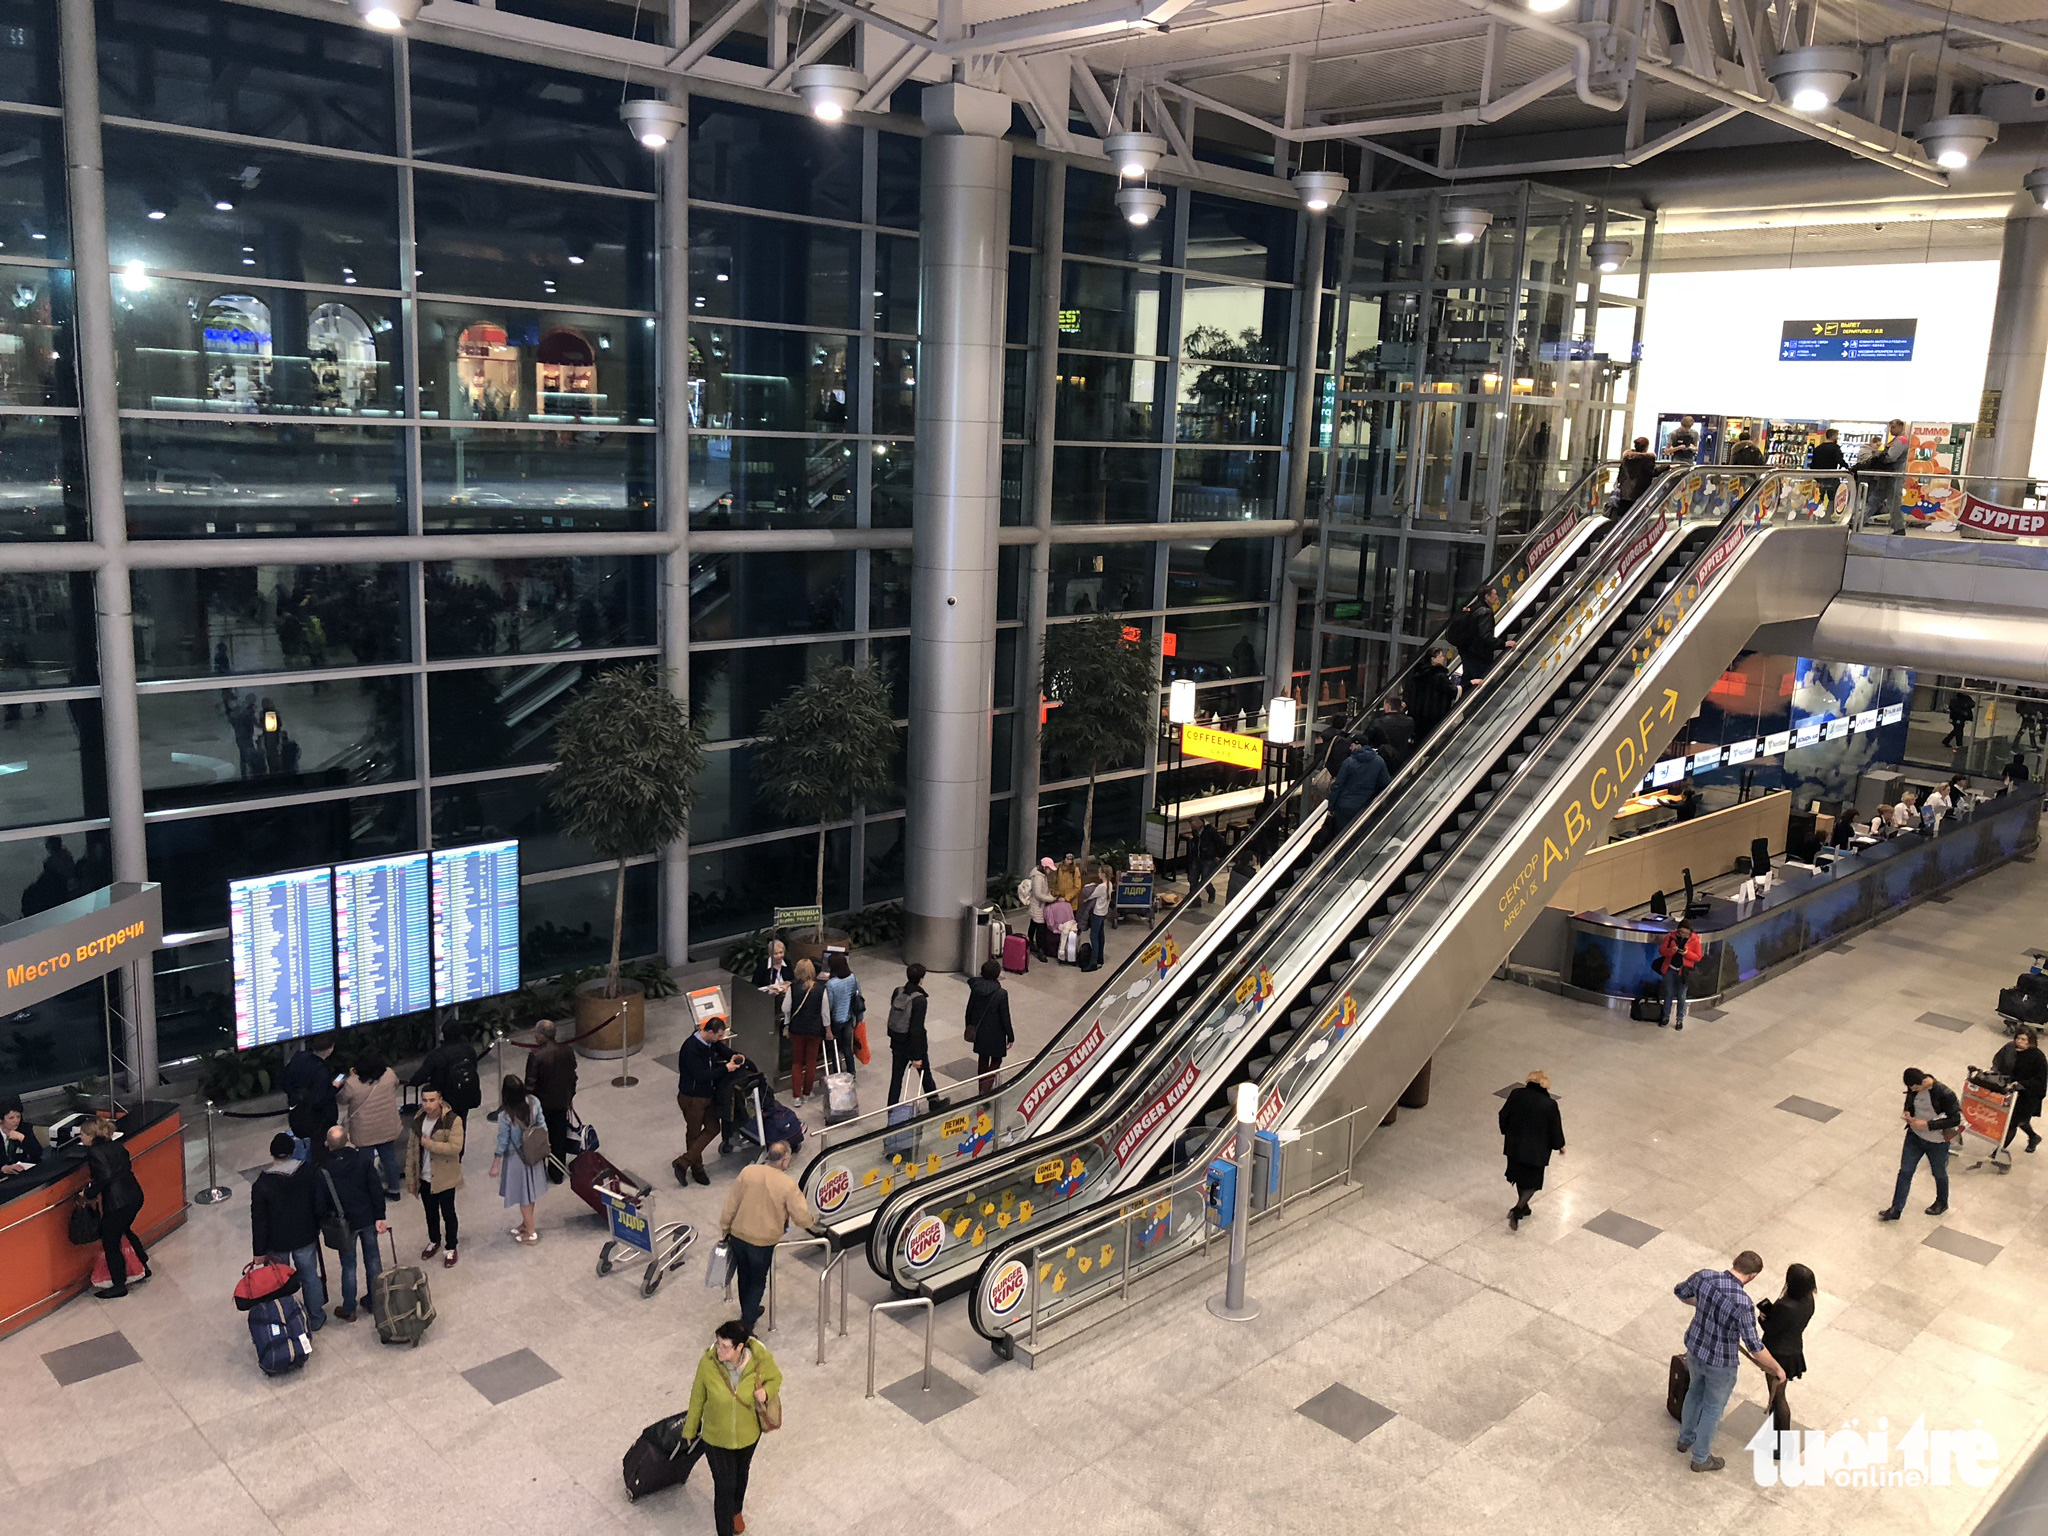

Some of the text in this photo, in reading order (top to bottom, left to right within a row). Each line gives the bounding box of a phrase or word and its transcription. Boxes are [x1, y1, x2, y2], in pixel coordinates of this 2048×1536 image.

[1914, 427, 1950, 436] ZUMMO
[1954, 445, 1962, 472] NATURAL
[1969, 506, 2044, 532] БУРГЕР
[1528, 512, 1574, 565] БУРГЕР КИНГ
[1620, 518, 1664, 574] BURGER KING
[1699, 526, 1742, 582] БУРГЕР КИНГ
[1186, 730, 1258, 752] COFFEEMOLKA
[1122, 886, 1146, 896] ЛДПР
[1498, 854, 1539, 912] СЕКТОР
[780, 908, 820, 918] ГОСТИНИЦА
[1503, 898, 1526, 932] AREA
[6, 920, 144, 989] Место встречи
[1022, 1028, 1100, 1114] БУРГЕР КИНГ
[944, 1116, 966, 1130] ЛЕТИМ,
[1118, 1068, 1195, 1159] BURGER KING
[1256, 1098, 1279, 1131] ИНГ
[818, 1170, 848, 1196] BURGER
[1038, 1164, 1052, 1174] COME
[820, 1178, 849, 1209] KING
[618, 1210, 646, 1232] ЛДПР
[910, 1222, 940, 1248] BURGER
[911, 1230, 940, 1262] KING
[992, 1266, 1022, 1296] BURGER
[994, 1274, 1023, 1310] KING
